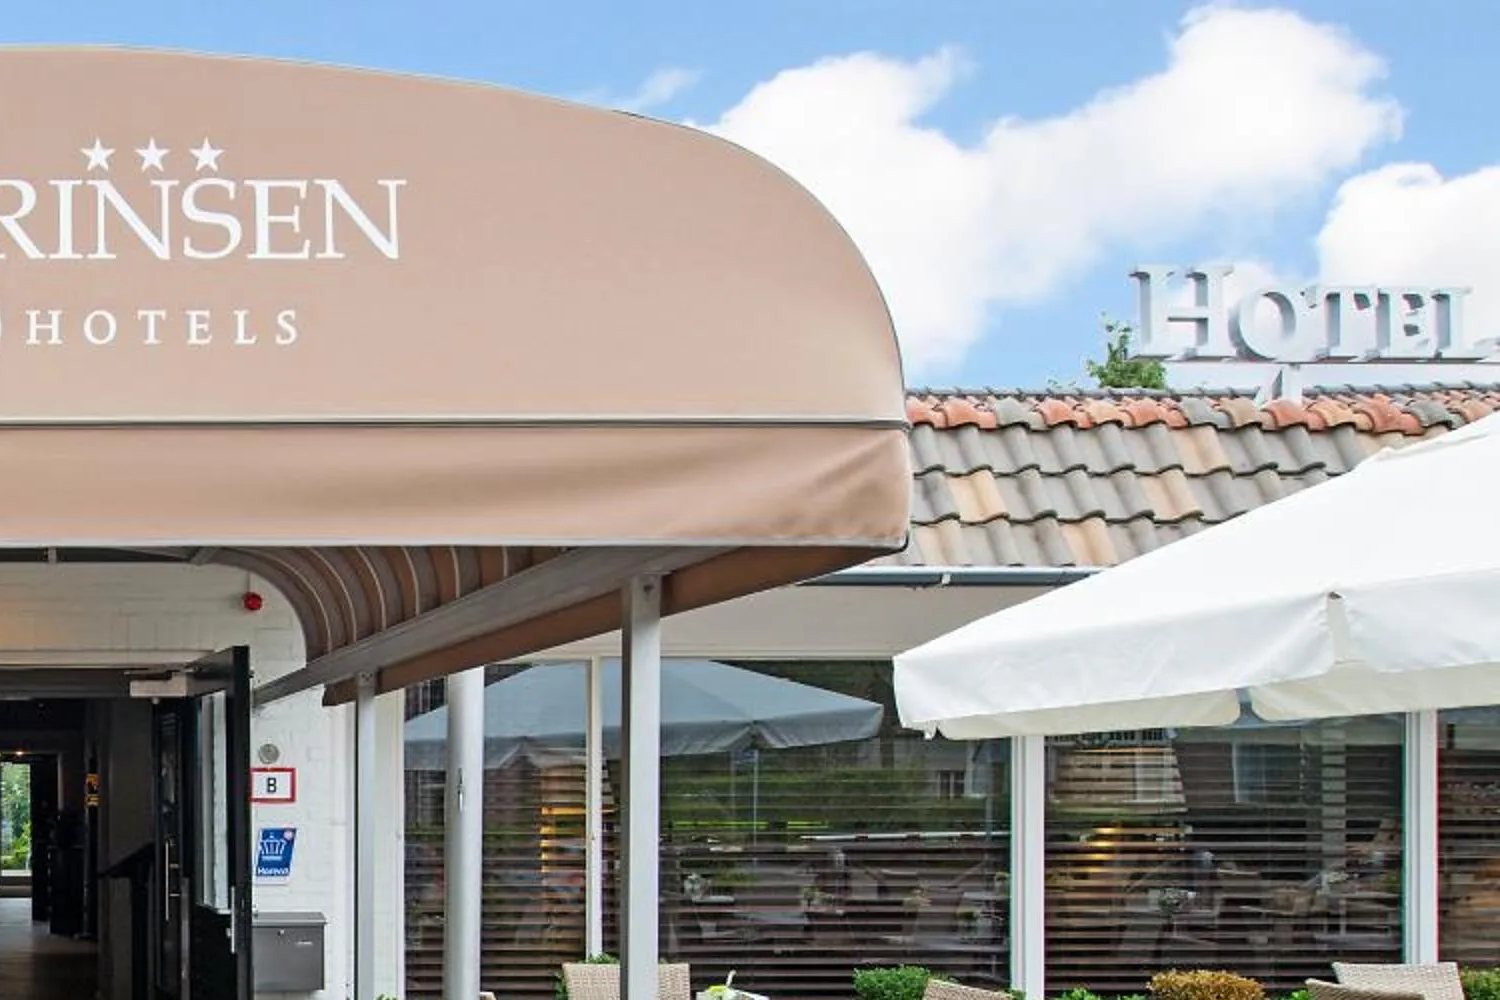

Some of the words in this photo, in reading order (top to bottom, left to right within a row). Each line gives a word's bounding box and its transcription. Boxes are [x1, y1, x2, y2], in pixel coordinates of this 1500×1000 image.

[25, 309, 298, 346] HOTELS
[1128, 264, 1500, 364] HOTEL
[266, 777, 278, 794] B
